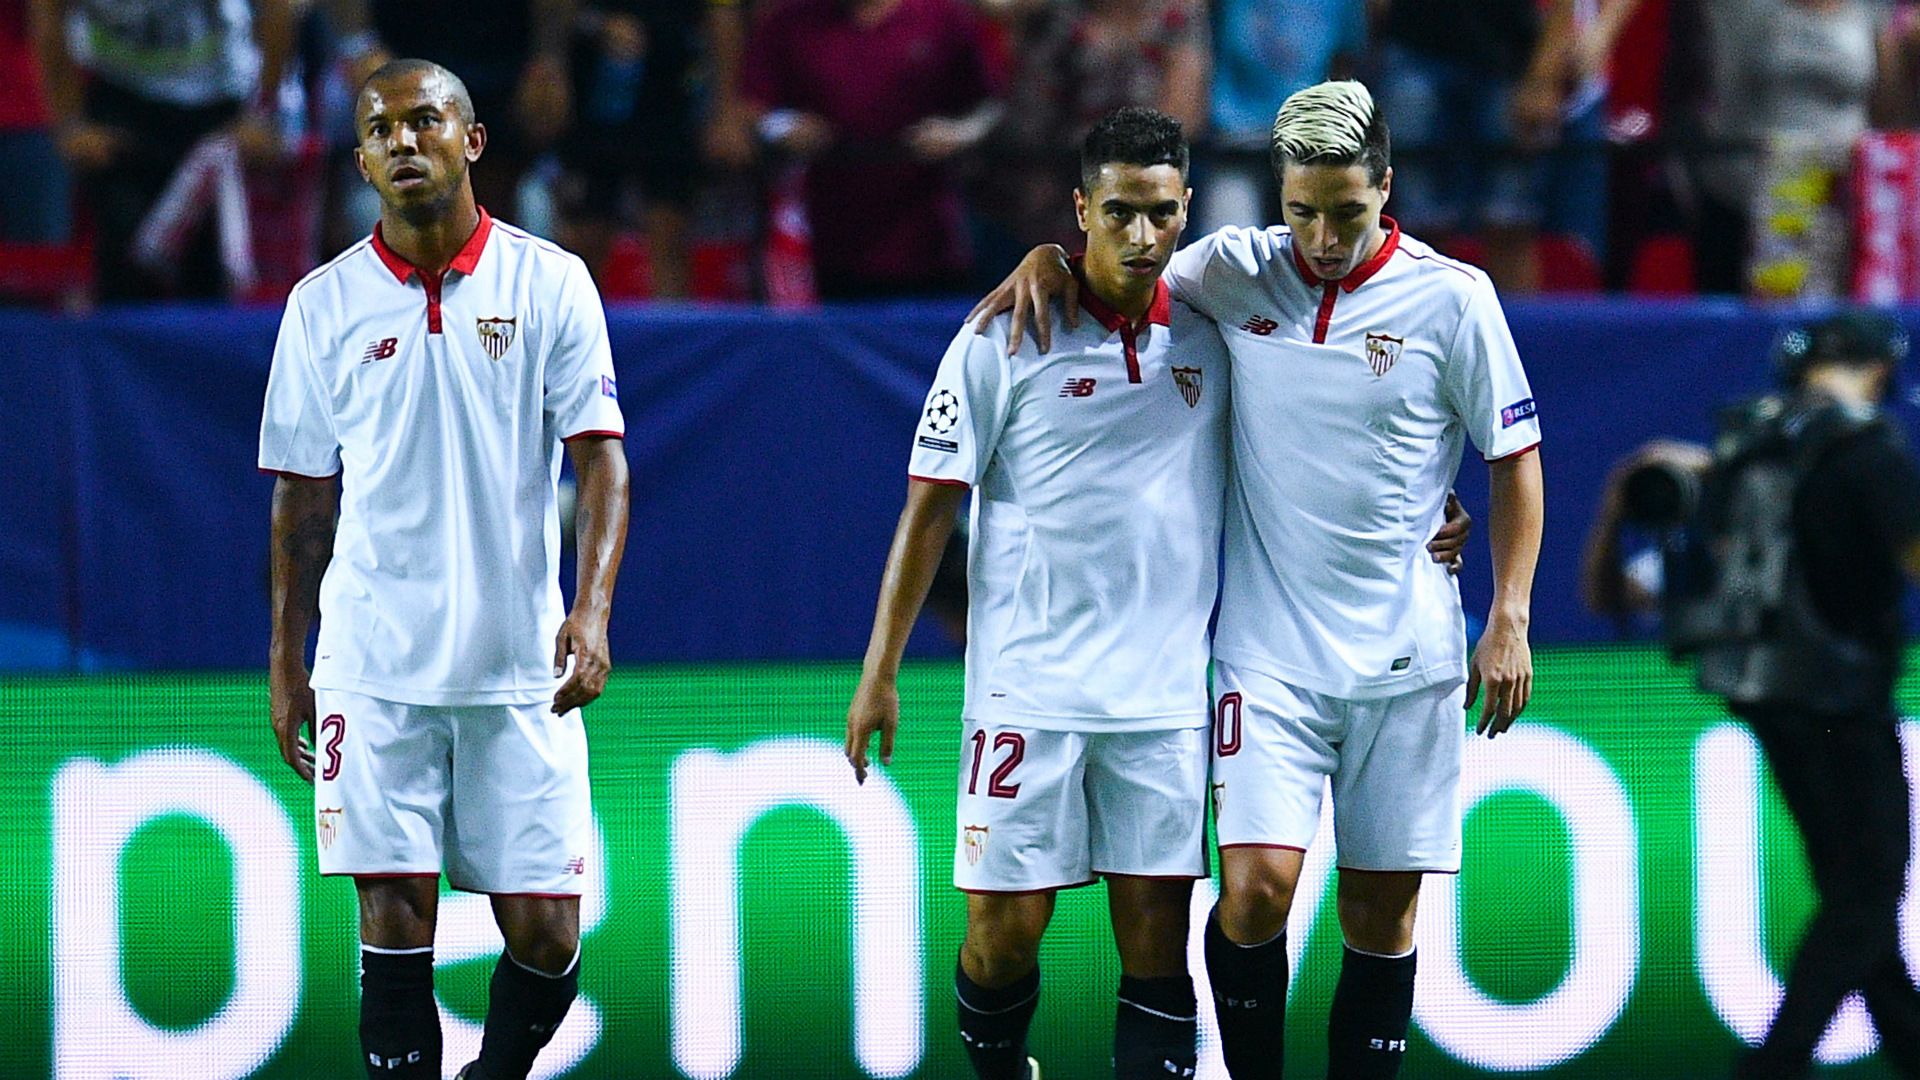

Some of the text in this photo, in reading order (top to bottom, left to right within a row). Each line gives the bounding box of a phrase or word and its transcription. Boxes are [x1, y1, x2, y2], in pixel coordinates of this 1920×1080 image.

[320, 714, 345, 781] 3
[1217, 691, 1242, 757] 0
[968, 729, 1026, 799] 12
